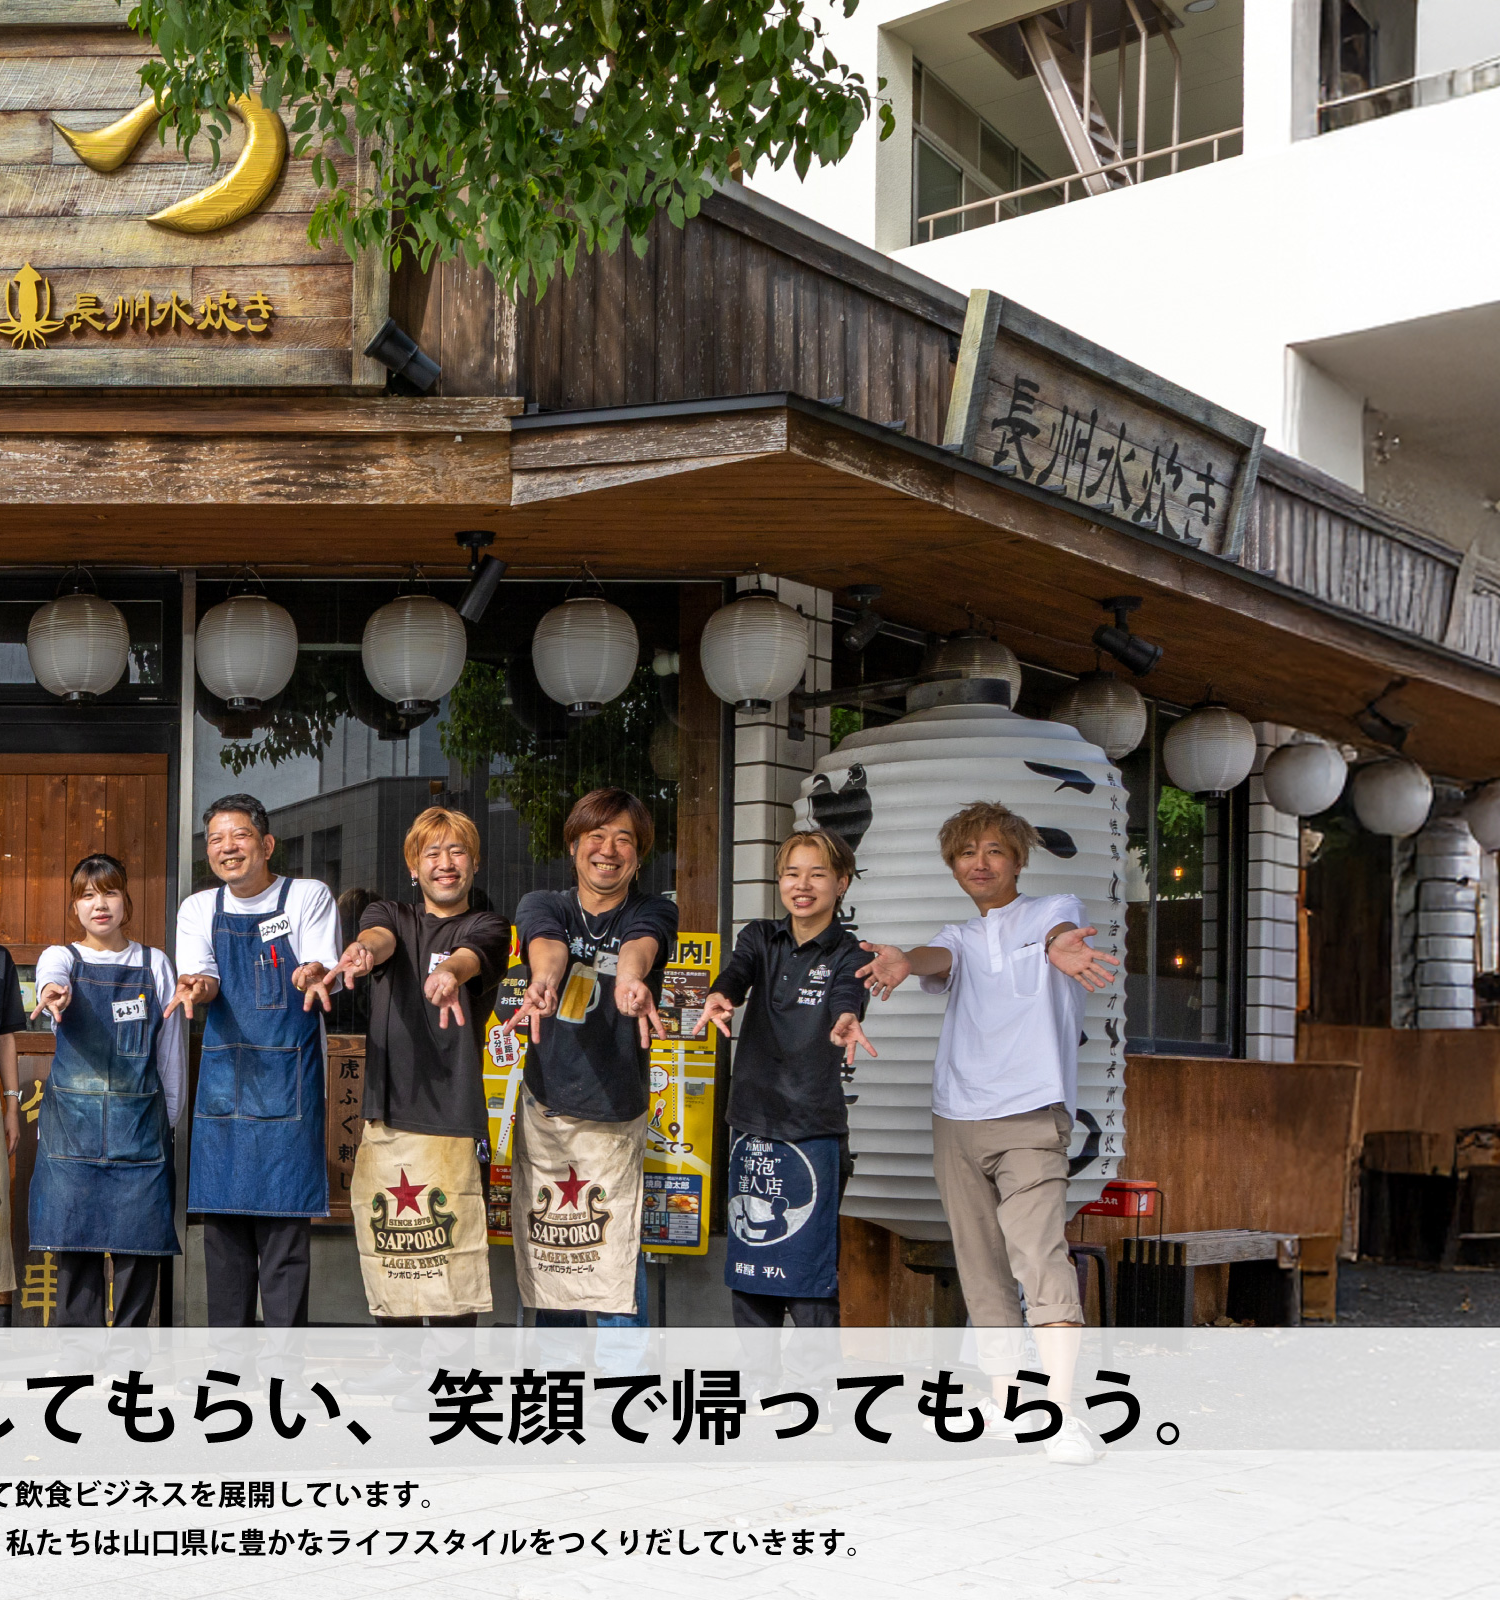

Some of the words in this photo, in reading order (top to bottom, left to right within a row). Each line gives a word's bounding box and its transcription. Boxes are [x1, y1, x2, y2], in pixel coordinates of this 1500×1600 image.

[63, 290, 275, 333] 長州水炊き
[991, 374, 1216, 541] 長州水炊き
[1105, 772, 1122, 862] 炭火焼鳥
[501, 978, 528, 987] 宇部の
[663, 976, 688, 984] こてつ
[116, 1004, 140, 1018] ひより
[503, 1032, 514, 1061] 近距離
[338, 1058, 361, 1191] 虎ふぐ刺し
[1101, 1061, 1118, 1176] 長州水炊き
[652, 1140, 694, 1154] こてつ
[738, 1174, 784, 1196] 達人店
[376, 1226, 447, 1251] SAPPORO
[531, 1222, 600, 1245] SAPPORO
[381, 1256, 417, 1269] LAGER
[419, 1254, 449, 1269] BEER
[533, 1247, 569, 1264] LAGER
[570, 1249, 601, 1264] BEER
[537, 1262, 595, 1274] サッポロラガービール
[762, 1266, 786, 1279] 平八
